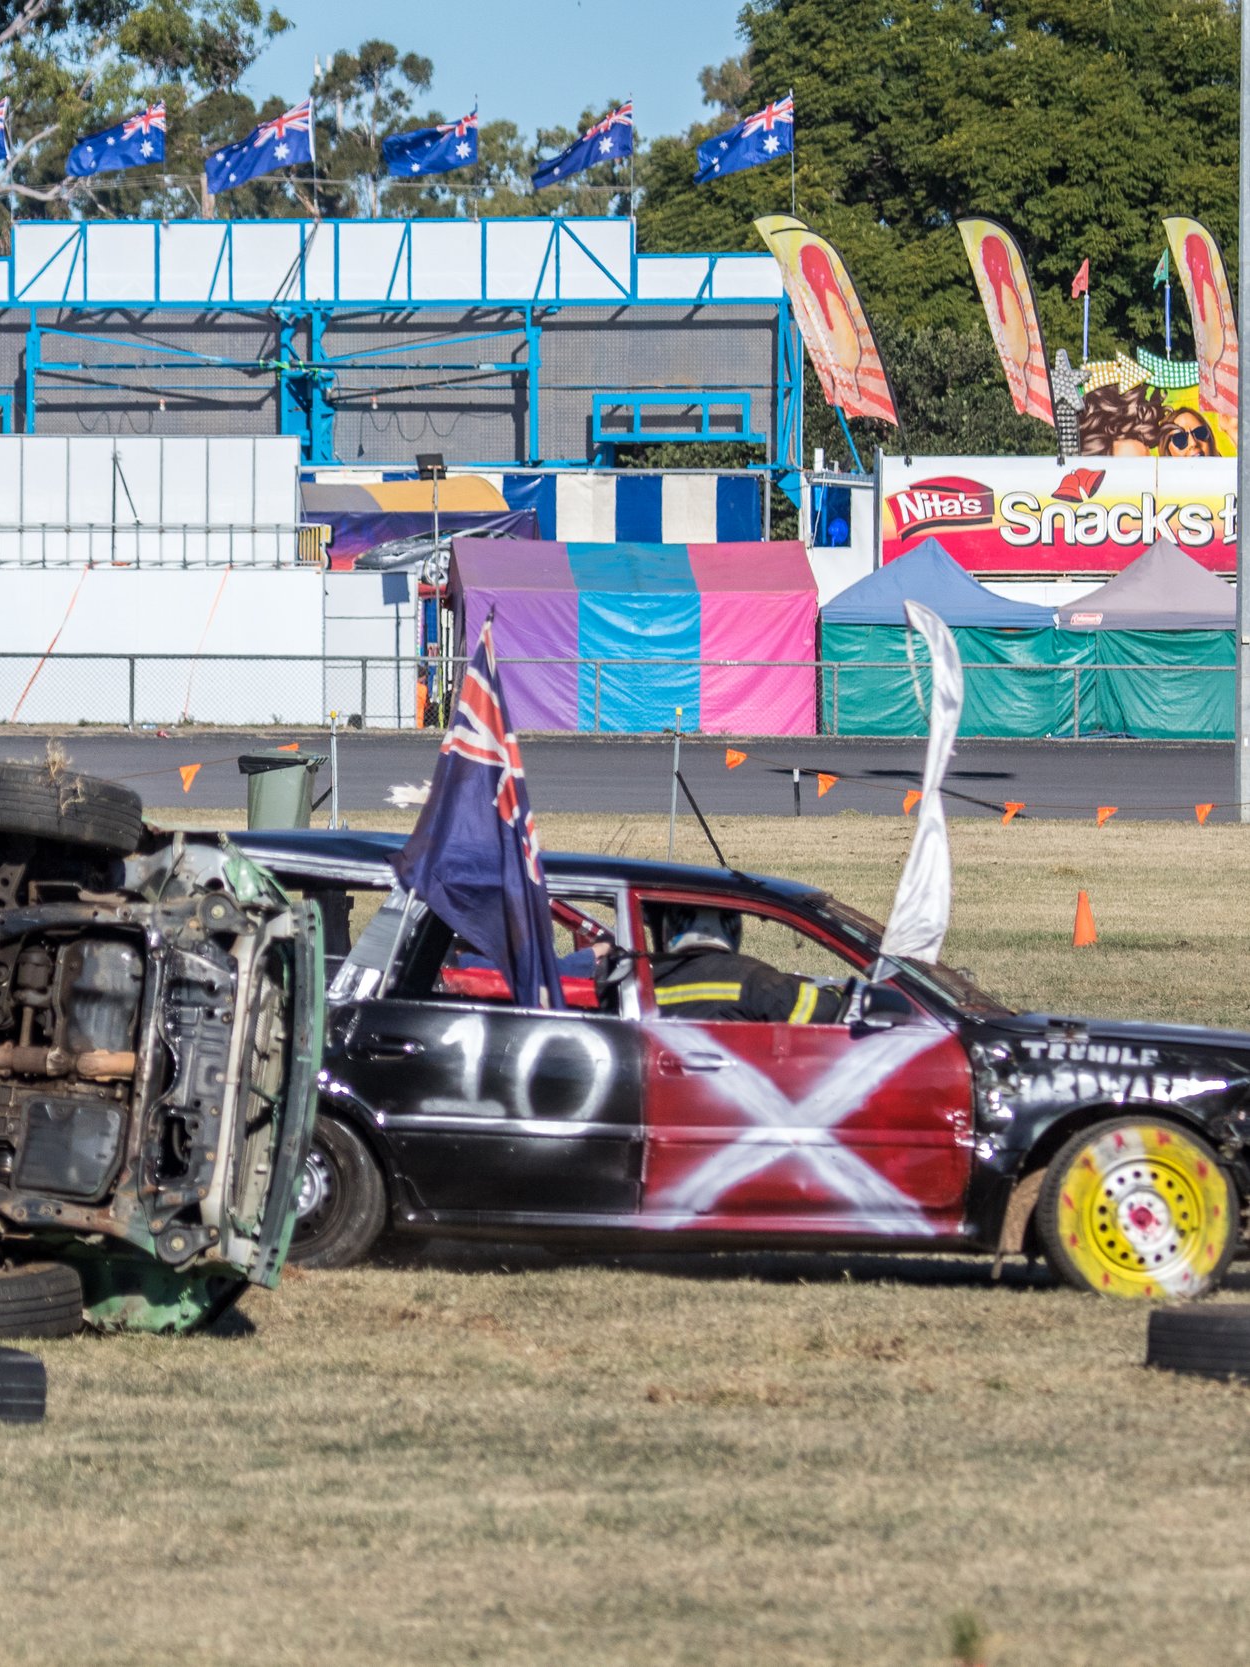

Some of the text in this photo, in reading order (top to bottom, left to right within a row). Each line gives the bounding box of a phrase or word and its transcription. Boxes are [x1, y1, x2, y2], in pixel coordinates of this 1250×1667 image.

[899, 490, 984, 524] Nita's
[999, 491, 1215, 548] Snacks
[418, 1012, 614, 1136] 10
